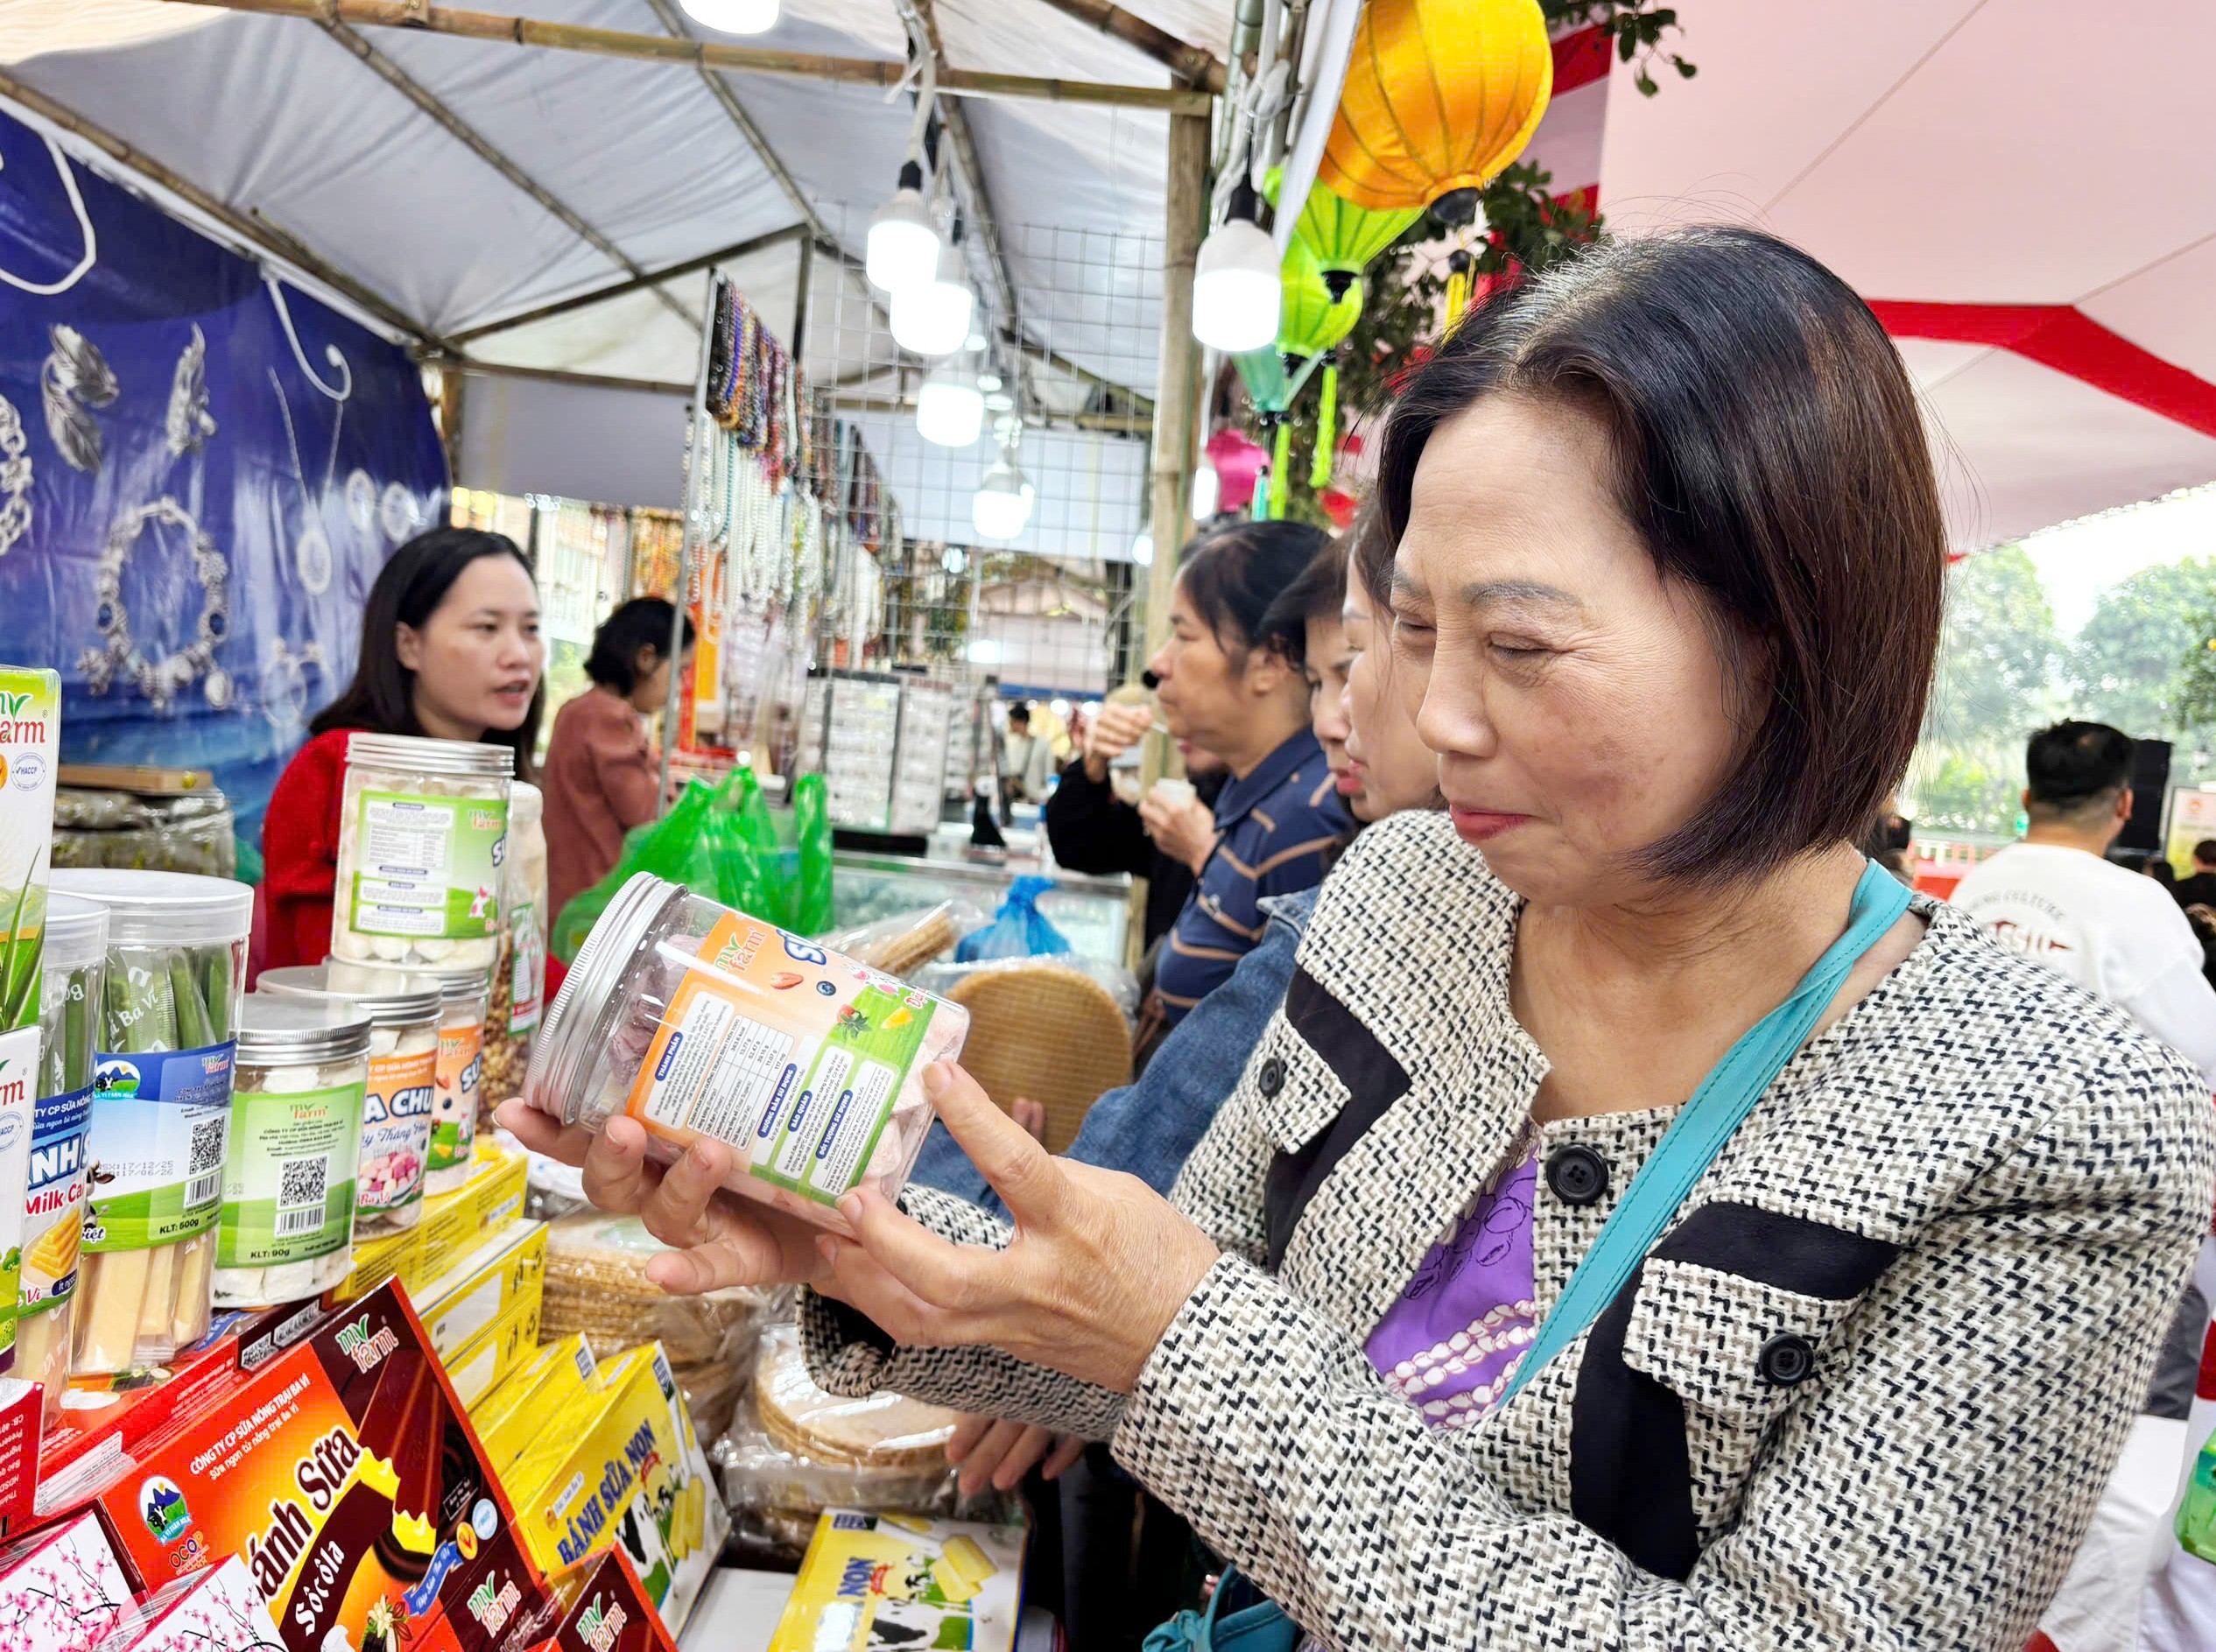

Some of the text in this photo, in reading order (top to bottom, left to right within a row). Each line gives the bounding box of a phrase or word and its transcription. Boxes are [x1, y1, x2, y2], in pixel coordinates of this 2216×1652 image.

[729, 931, 766, 972] farm
[656, 1034, 680, 1077] THÀNH PHẦN
[48, 1107, 60, 1115] CP
[61, 1100, 75, 1113] SỮA
[294, 1107, 327, 1120] farm
[760, 1109, 775, 1133] HƯỚNG
[780, 1068, 794, 1088] DỤNG
[790, 1093, 810, 1128] BẢO QUẢN
[823, 1121, 838, 1143] TƯỢNG
[837, 1093, 851, 1113] DỤNG
[26, 1187, 63, 1215] Milk
[159, 1222, 178, 1234] KLT:
[272, 1248, 291, 1258] 90g
[336, 1314, 369, 1356] my
[351, 1325, 398, 1374] farm
[190, 1373, 310, 1474] CÔNG TY CP SỮA NÔNG TRẠI BA VÌ
[209, 1464, 224, 1480] Sữa
[225, 1451, 243, 1469] ngon
[252, 1428, 271, 1447] nông
[299, 1429, 360, 1511] Sữa
[557, 1499, 609, 1565] BÁNH
[598, 1459, 632, 1513] SỮA
[624, 1418, 657, 1474] NON
[170, 1531, 204, 1568] OCOP
[295, 1541, 345, 1637] Sôcôla
[467, 1571, 495, 1623] my
[837, 1557, 876, 1597] NON
[478, 1578, 521, 1637] farm
[576, 1592, 602, 1643] my
[588, 1601, 627, 1652] farm
